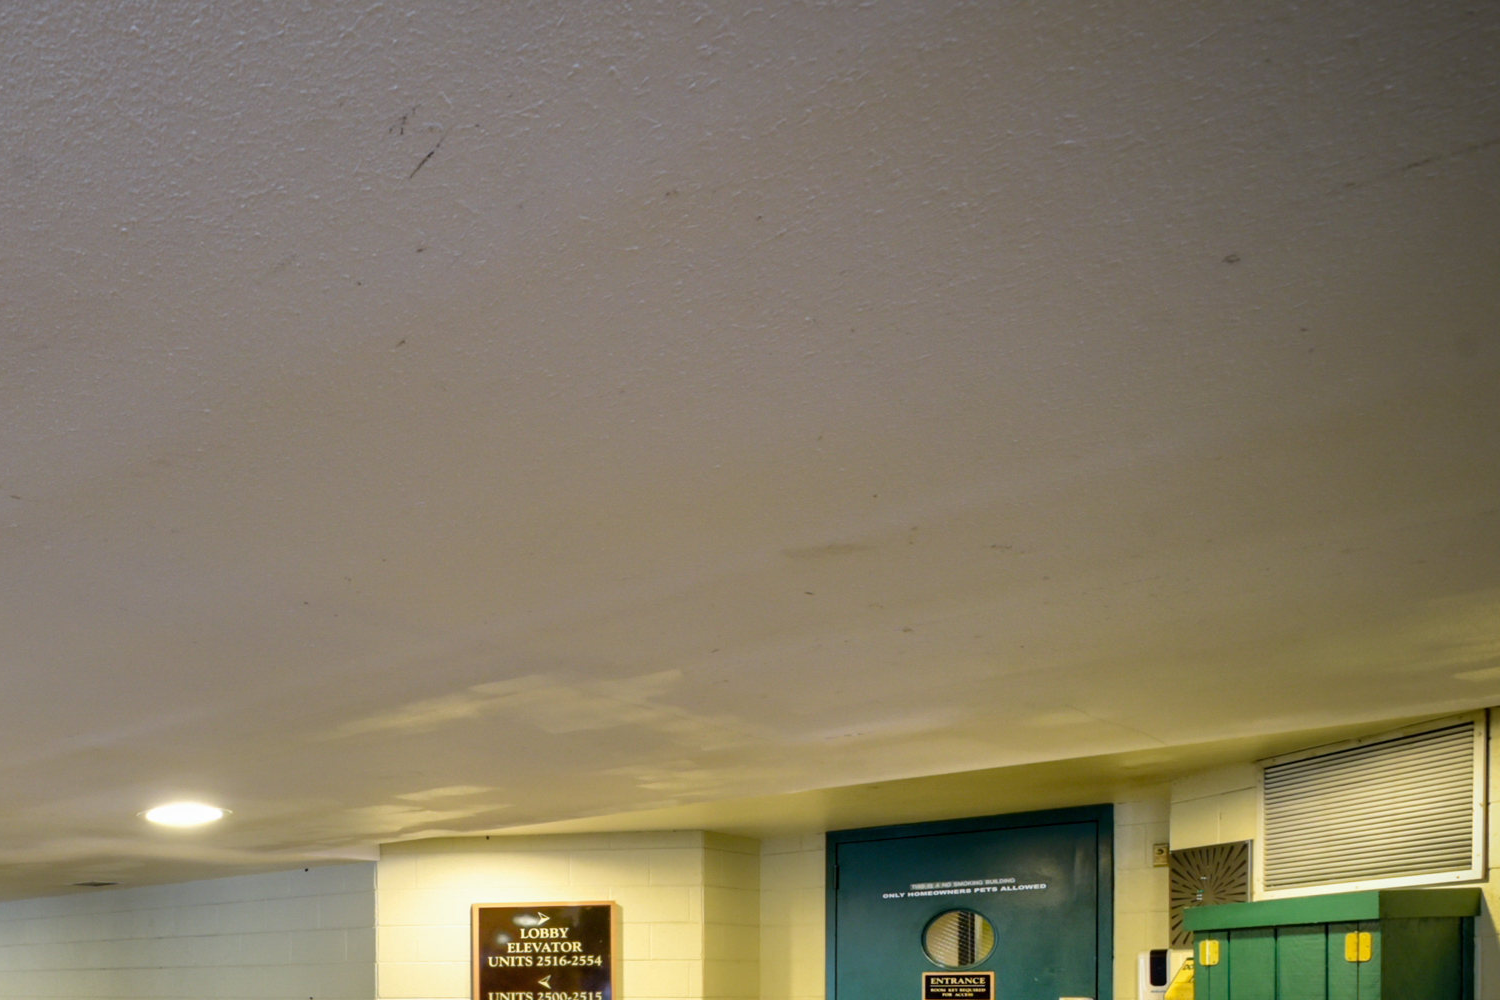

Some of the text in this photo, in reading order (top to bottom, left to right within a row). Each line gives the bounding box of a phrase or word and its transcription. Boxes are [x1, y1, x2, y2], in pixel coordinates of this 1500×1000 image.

[907, 888, 971, 897] HOMEOWNERS
[1000, 883, 1047, 892] ALLOWED
[520, 928, 569, 939] LOBBY
[507, 942, 582, 953] ELEVATOR
[488, 955, 602, 967] UNITS 2516-2554
[930, 977, 986, 985] ENTRANCE
